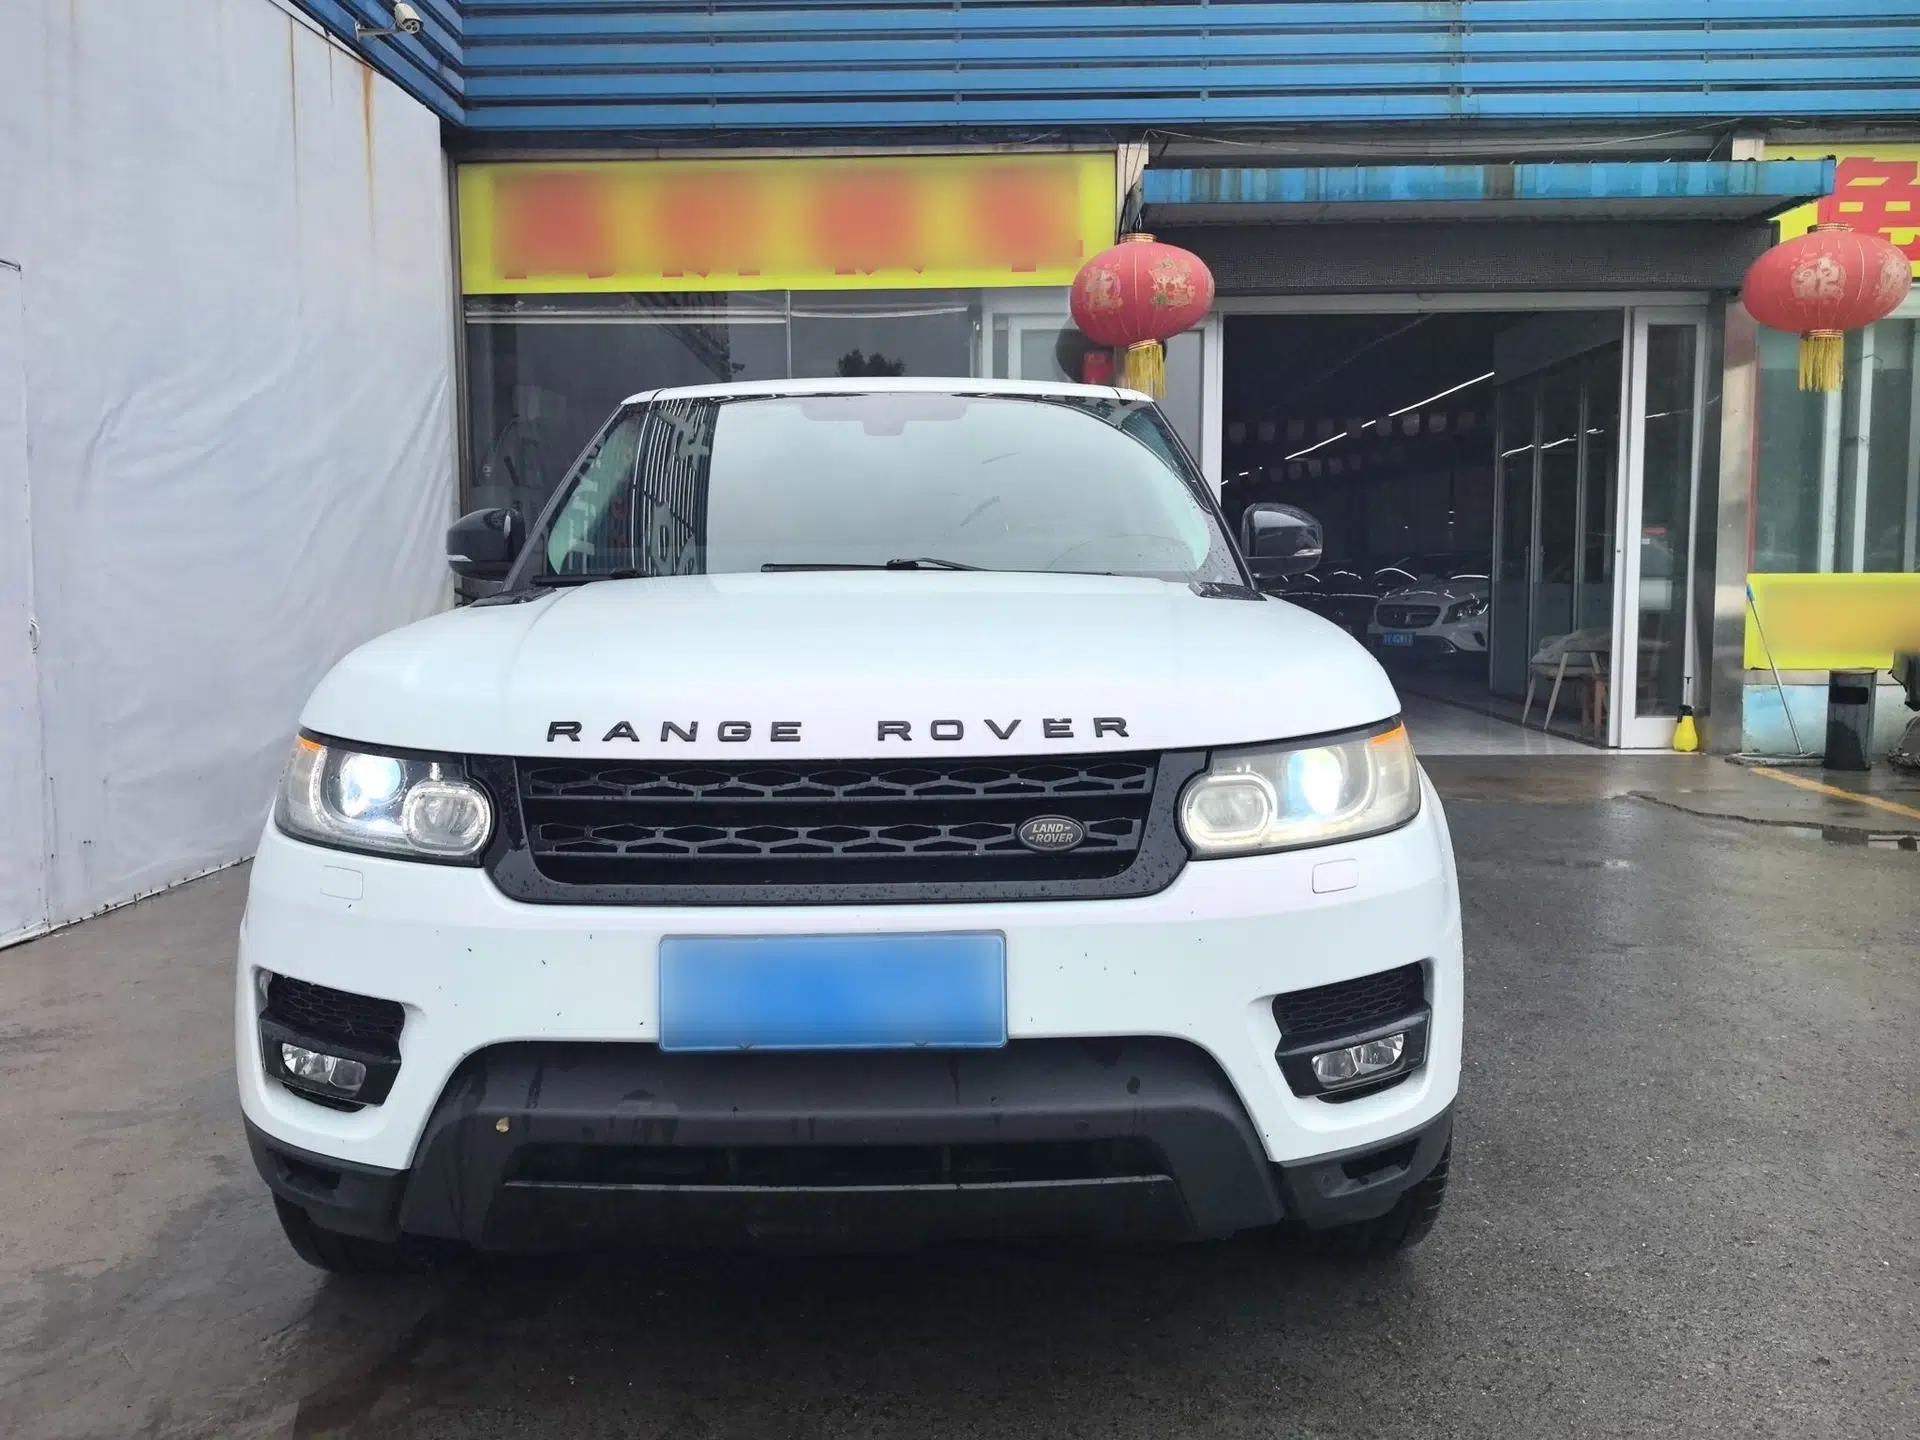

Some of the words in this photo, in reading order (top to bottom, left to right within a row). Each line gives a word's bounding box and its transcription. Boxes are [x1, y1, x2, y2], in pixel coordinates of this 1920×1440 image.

[546, 720, 802, 743] RANGE
[877, 716, 1130, 742] ROVER
[1032, 823, 1064, 834] LAND
[1035, 833, 1074, 843] ROVER
